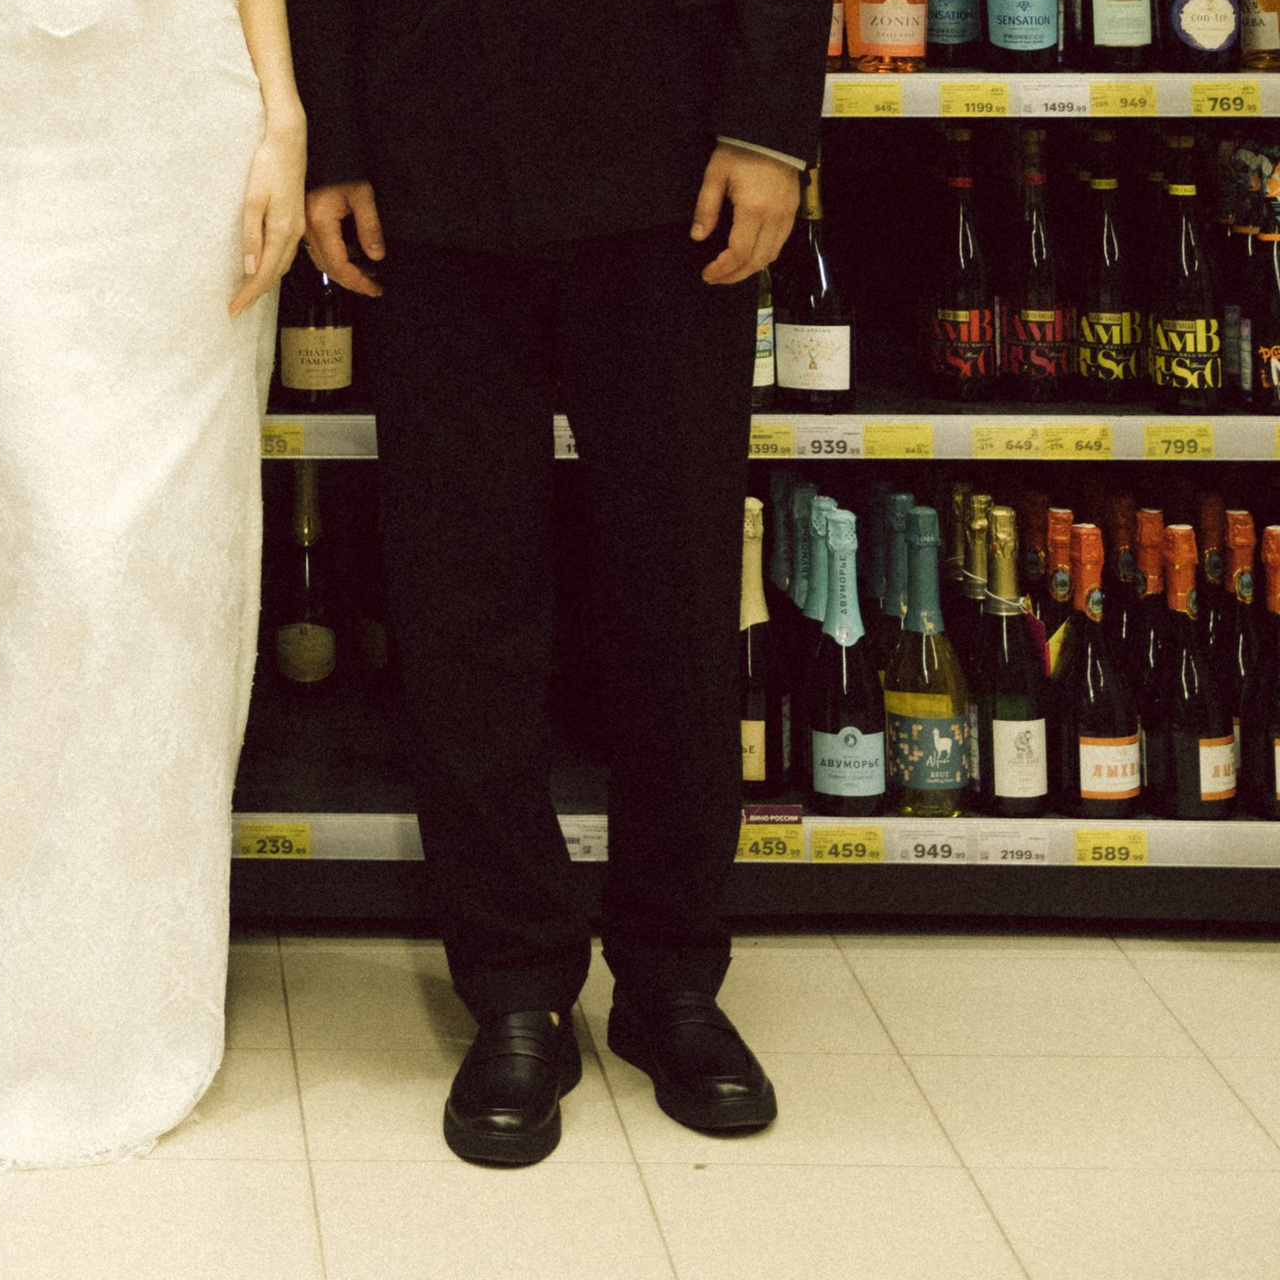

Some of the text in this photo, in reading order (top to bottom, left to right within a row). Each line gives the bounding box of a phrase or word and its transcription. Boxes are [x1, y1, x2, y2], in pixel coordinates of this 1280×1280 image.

[996, 14, 1051, 26] SENSATION
[811, 439, 860, 456] 939.99
[839, 554, 847, 615] ДВУМОРЬЕ
[820, 758, 880, 769] ДВУМОРЬЕ
[749, 840, 800, 856] 459.99
[828, 842, 879, 858] 459.99
[914, 843, 965, 859] 949.99
[1000, 849, 1045, 860] 2199.99
